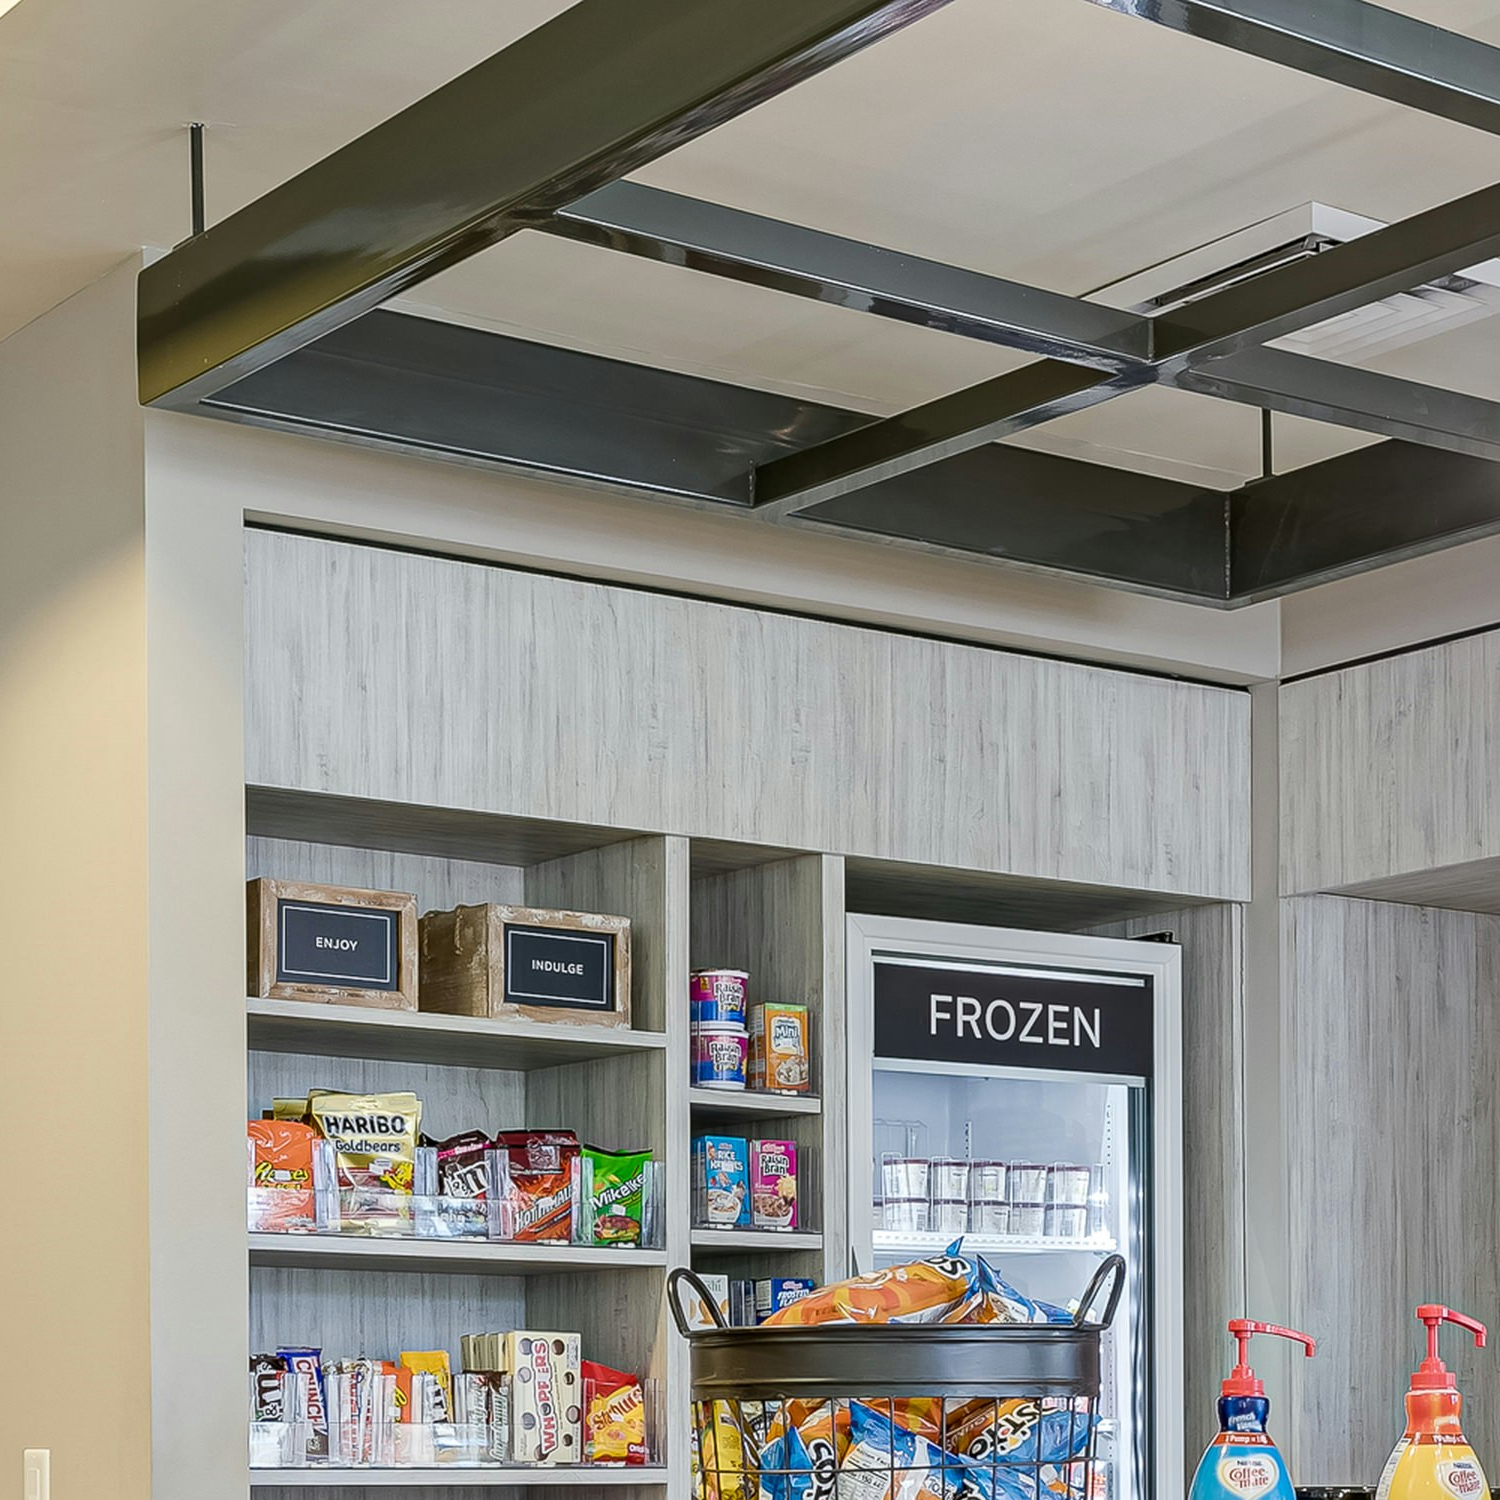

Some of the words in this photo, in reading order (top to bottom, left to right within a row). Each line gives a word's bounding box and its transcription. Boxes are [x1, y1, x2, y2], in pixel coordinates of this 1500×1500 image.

[315, 936, 358, 952] ENJOY
[531, 959, 584, 976] INDULGE
[930, 994, 1100, 1048] FROZEN
[335, 1138, 402, 1153] Goldbears
[764, 1163, 786, 1175] Bran
